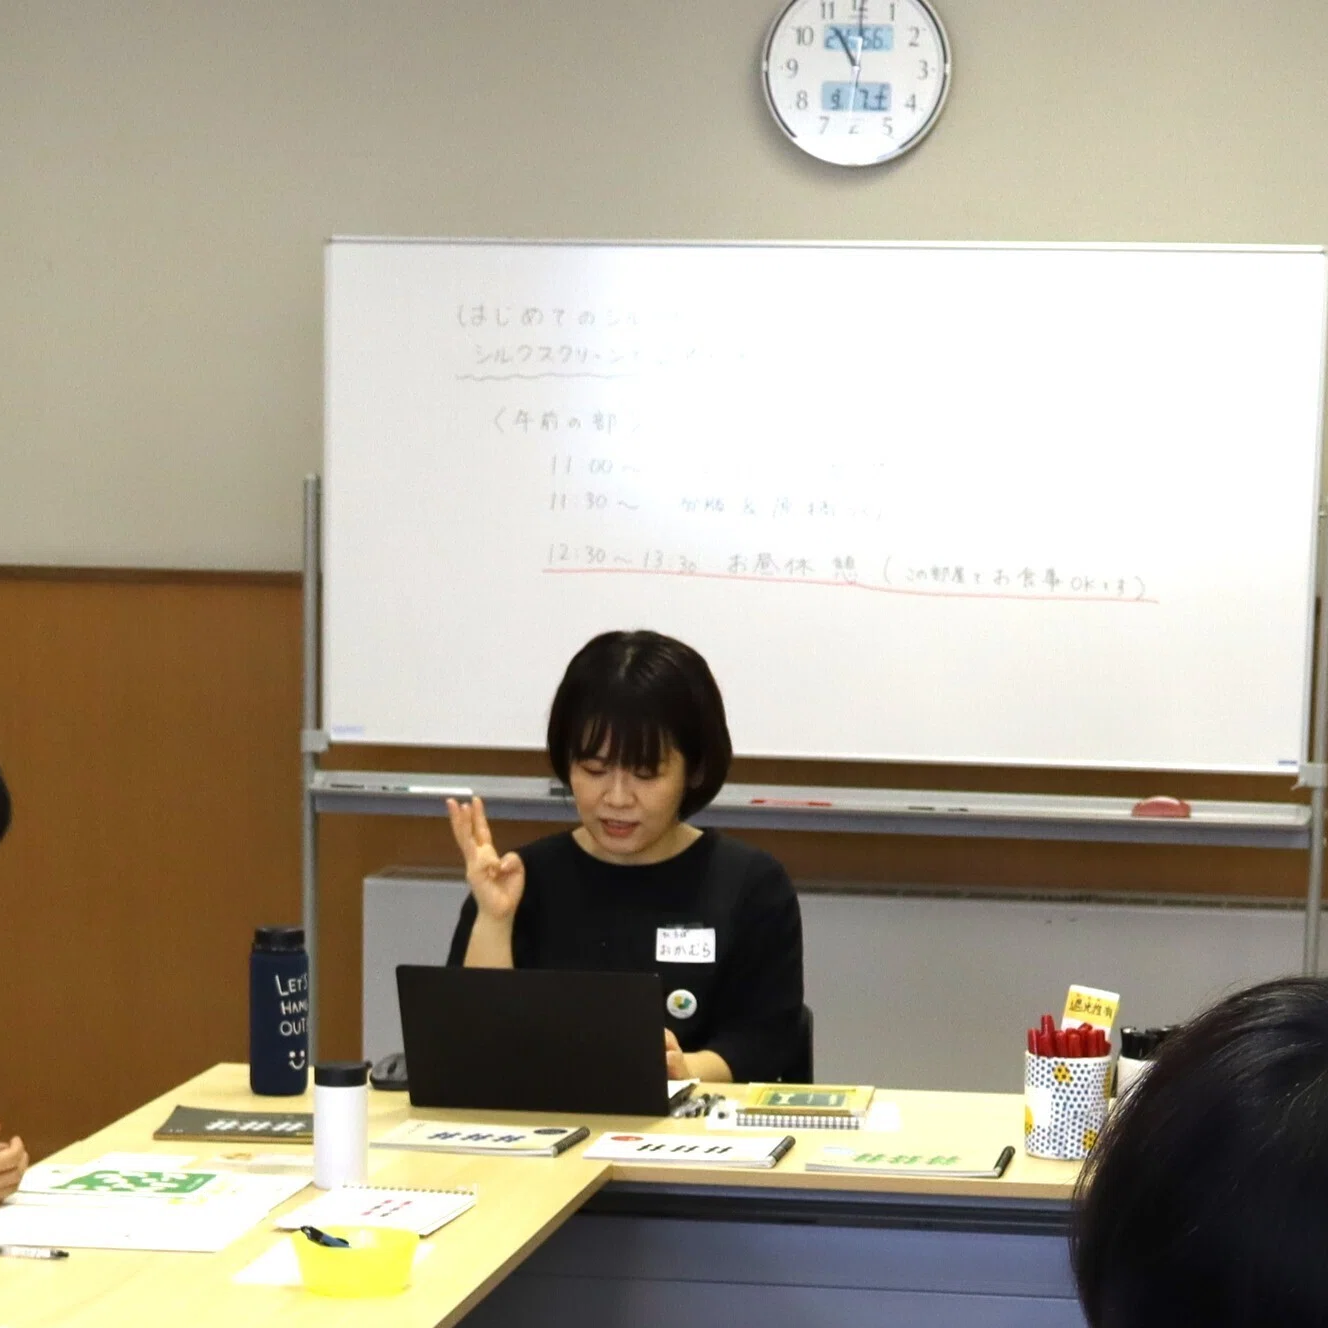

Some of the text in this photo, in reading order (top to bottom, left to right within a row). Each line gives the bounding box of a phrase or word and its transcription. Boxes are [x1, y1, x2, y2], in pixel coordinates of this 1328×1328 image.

[889, 3, 895, 21] 1
[796, 27, 814, 46] 10
[909, 27, 920, 47] 2
[786, 59, 799, 78] 9
[918, 60, 929, 80] 3
[796, 91, 809, 110] 8
[904, 93, 916, 112] 4
[819, 116, 830, 135] 7
[882, 116, 895, 138] 5
[281, 1000, 308, 1015] HAN
